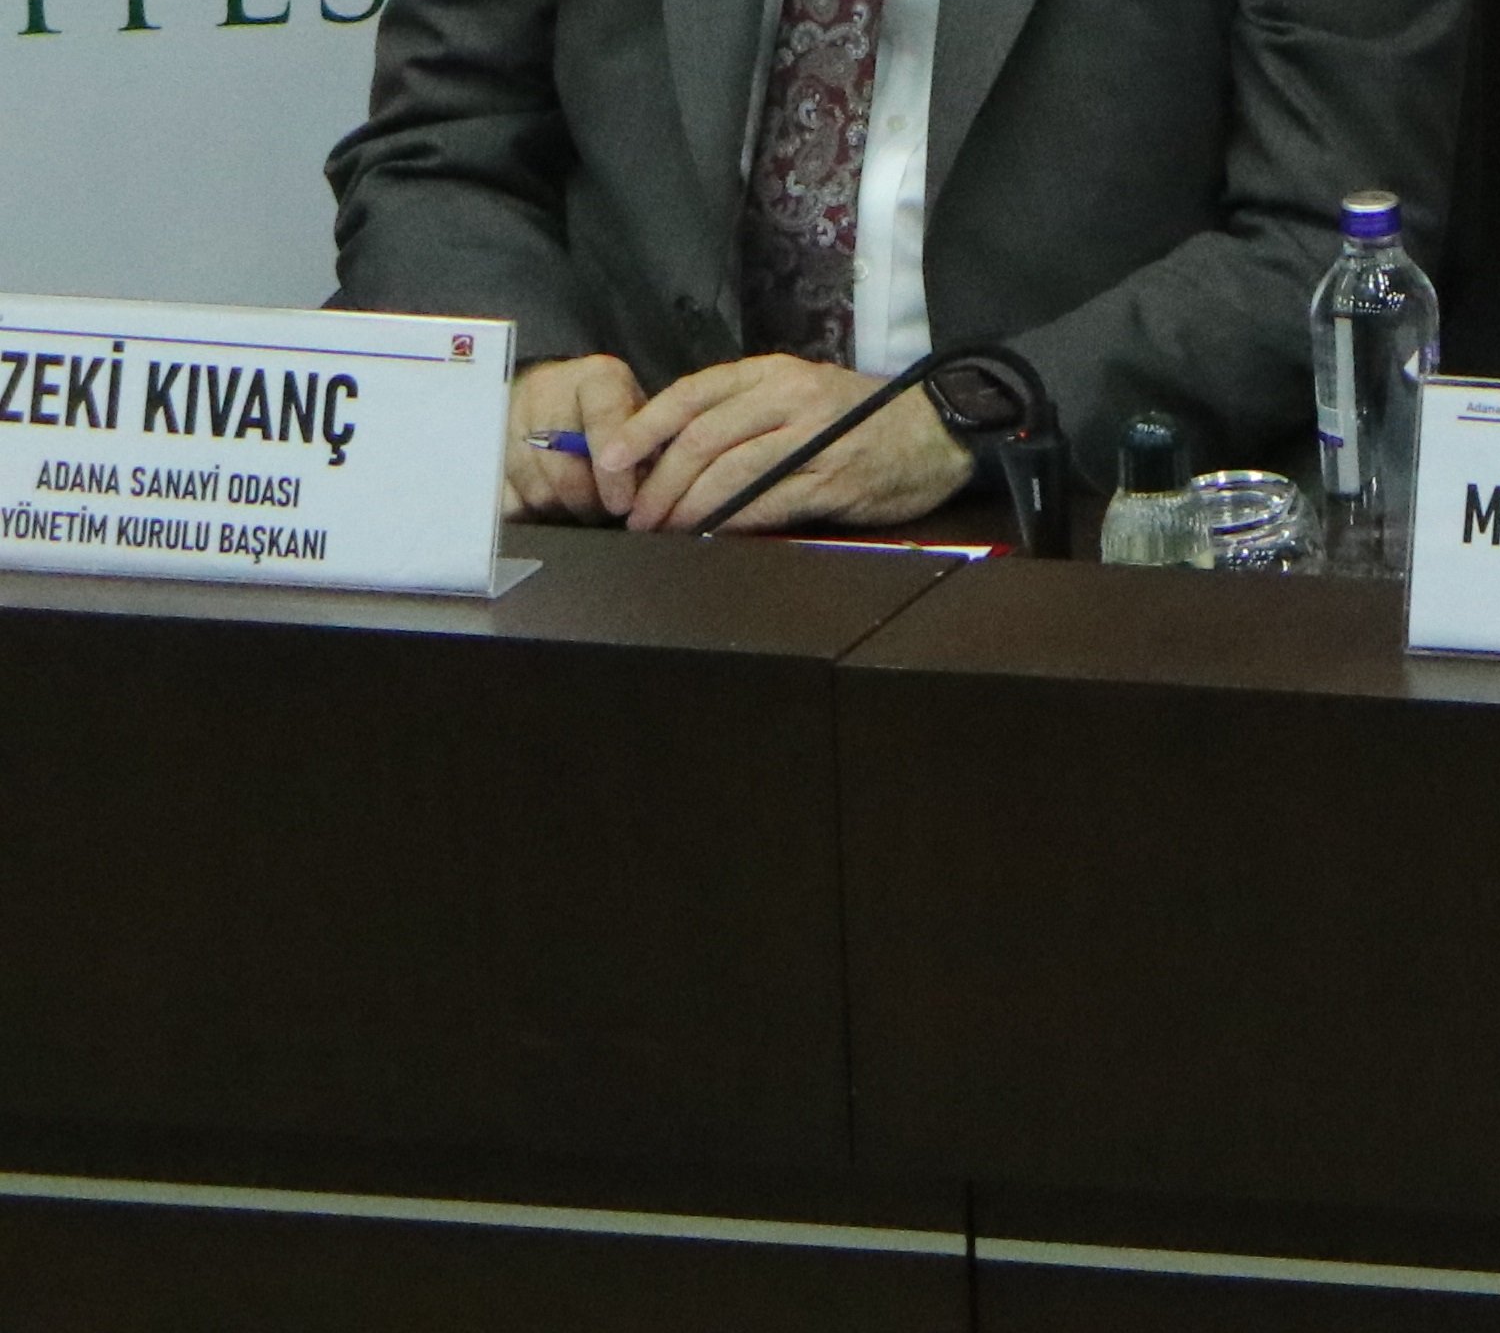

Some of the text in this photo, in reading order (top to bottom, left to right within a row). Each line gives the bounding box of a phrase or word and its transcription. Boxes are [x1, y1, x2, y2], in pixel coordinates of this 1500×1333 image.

[0, 341, 359, 466] ZEKİ KIVANÇ
[36, 459, 301, 508] ADANA SANAYİ ODASI
[0, 501, 327, 565] YÖNETİM KURULU BAŞKANI
